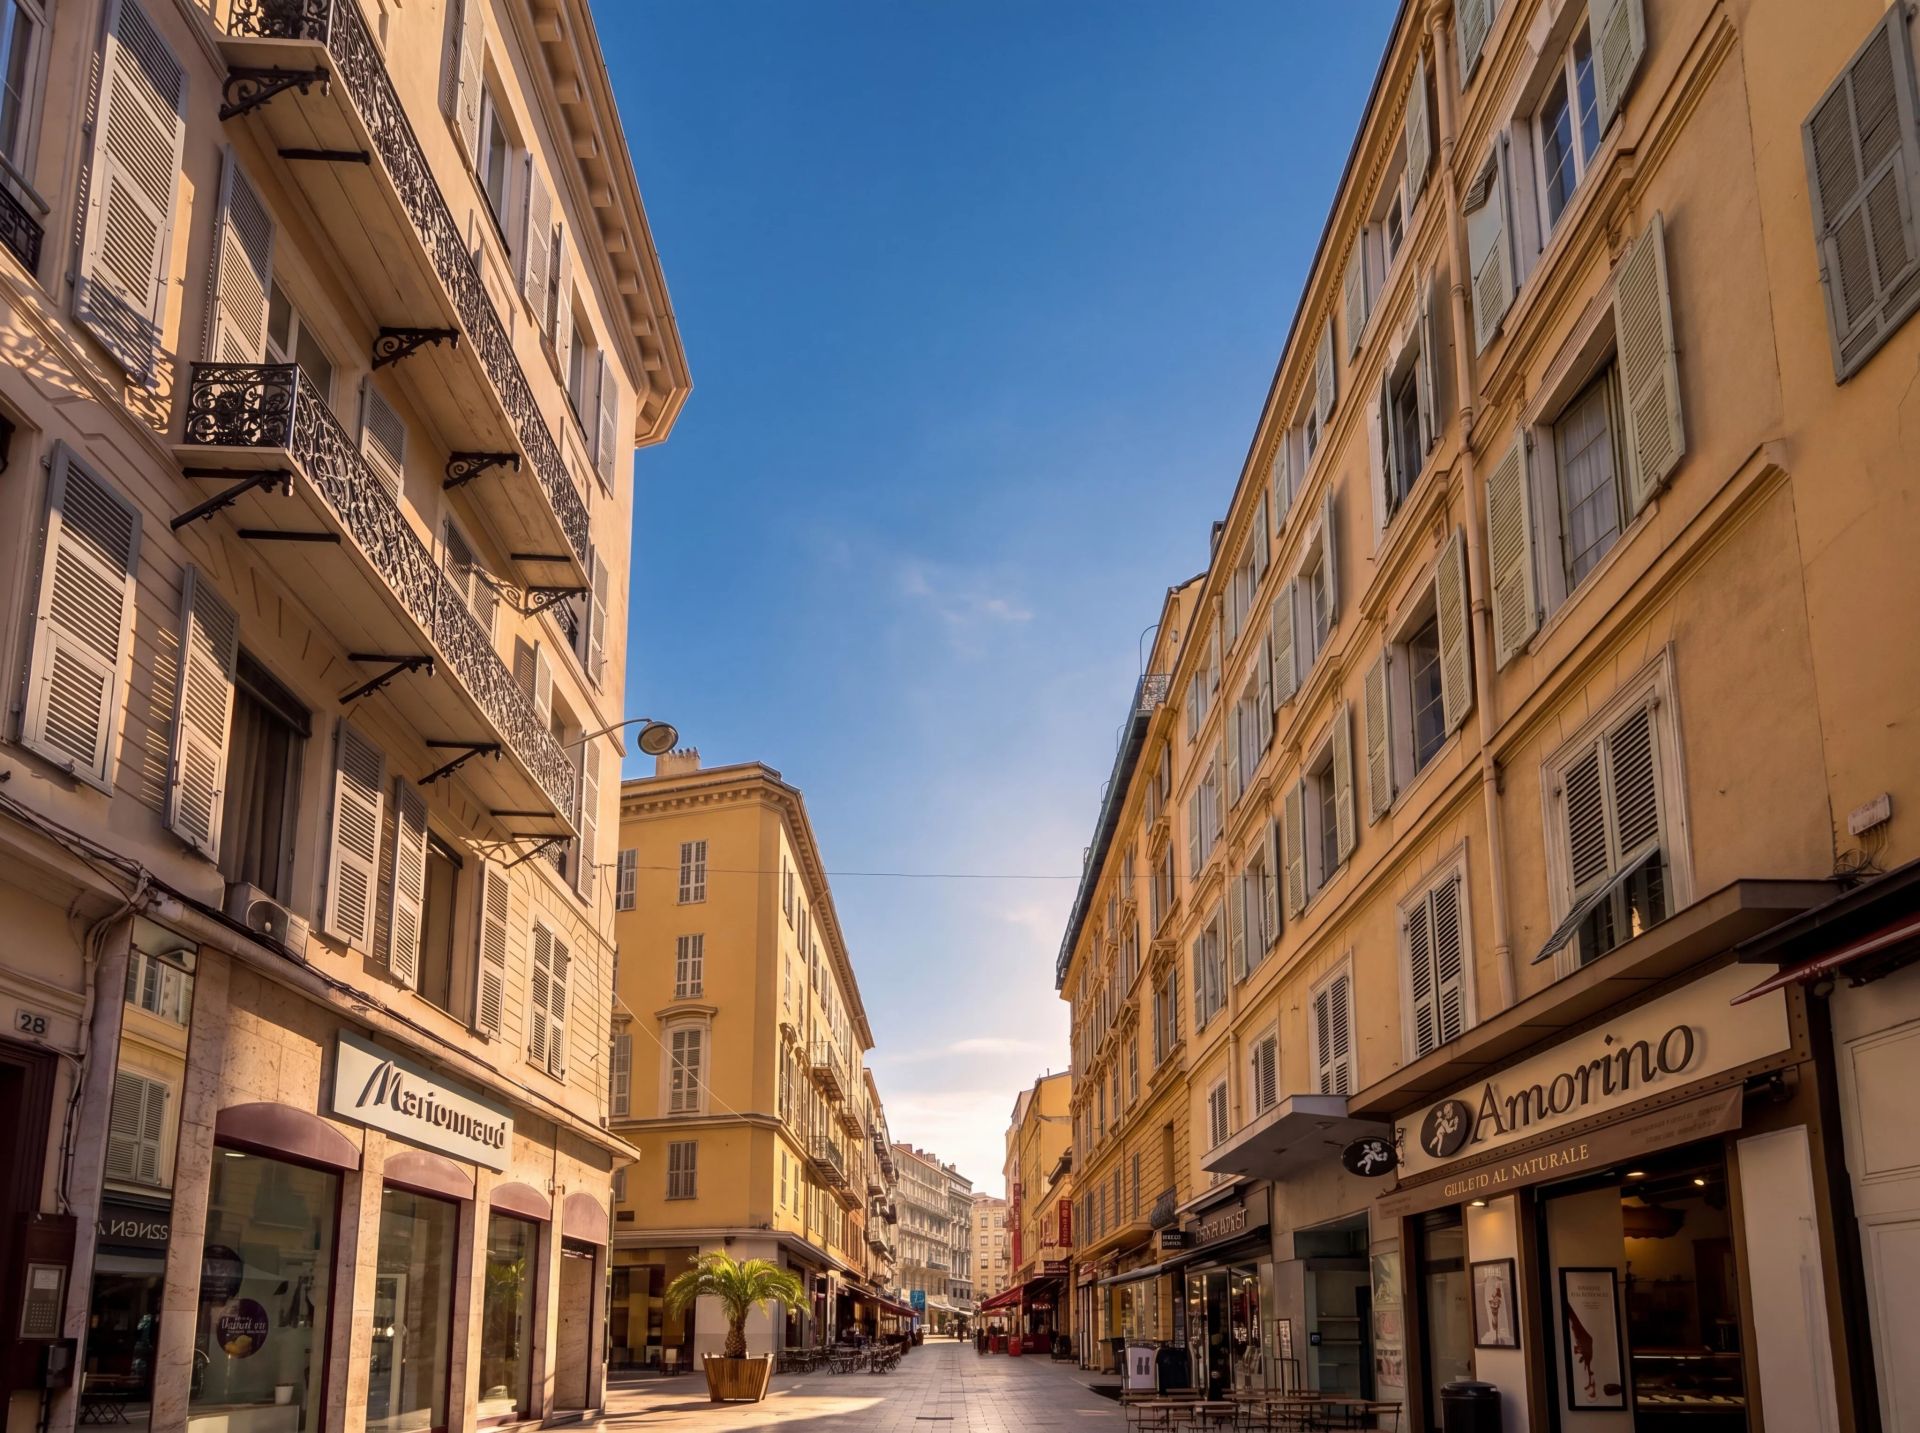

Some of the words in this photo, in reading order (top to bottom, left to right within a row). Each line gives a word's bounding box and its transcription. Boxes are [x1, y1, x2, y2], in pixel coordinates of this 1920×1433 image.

[20, 1013, 46, 1034] 28
[1470, 1024, 1695, 1145] Amorino
[1492, 1168, 1509, 1185] AL
[1512, 1144, 1590, 1179] NATURALE
